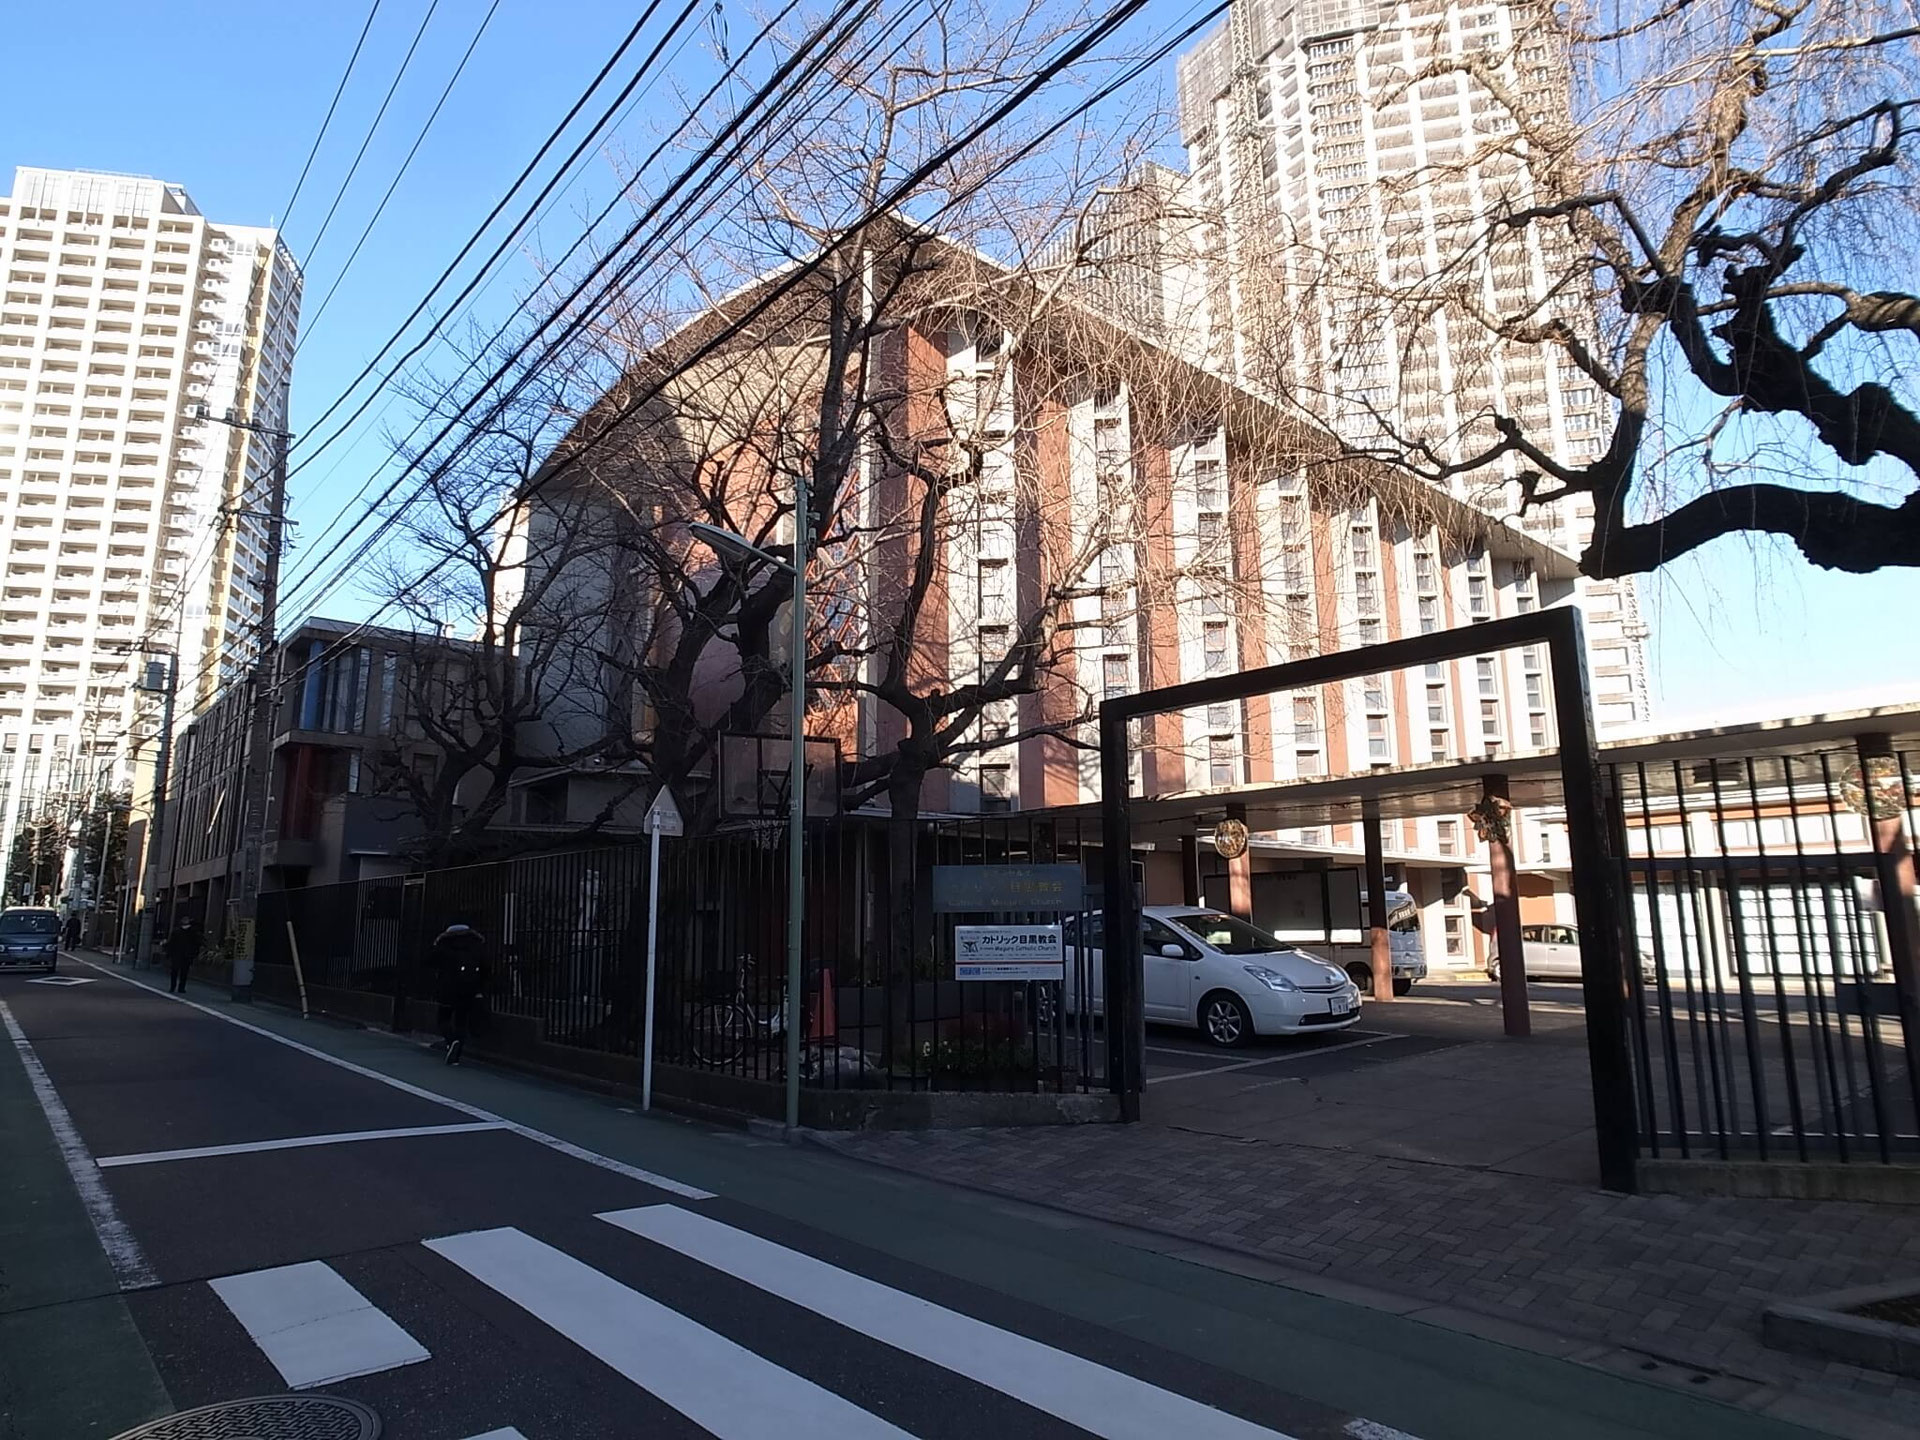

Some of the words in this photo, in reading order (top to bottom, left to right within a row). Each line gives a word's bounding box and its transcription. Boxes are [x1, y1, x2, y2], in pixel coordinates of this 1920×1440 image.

[982, 934, 1057, 944] カトリック目黒教会
